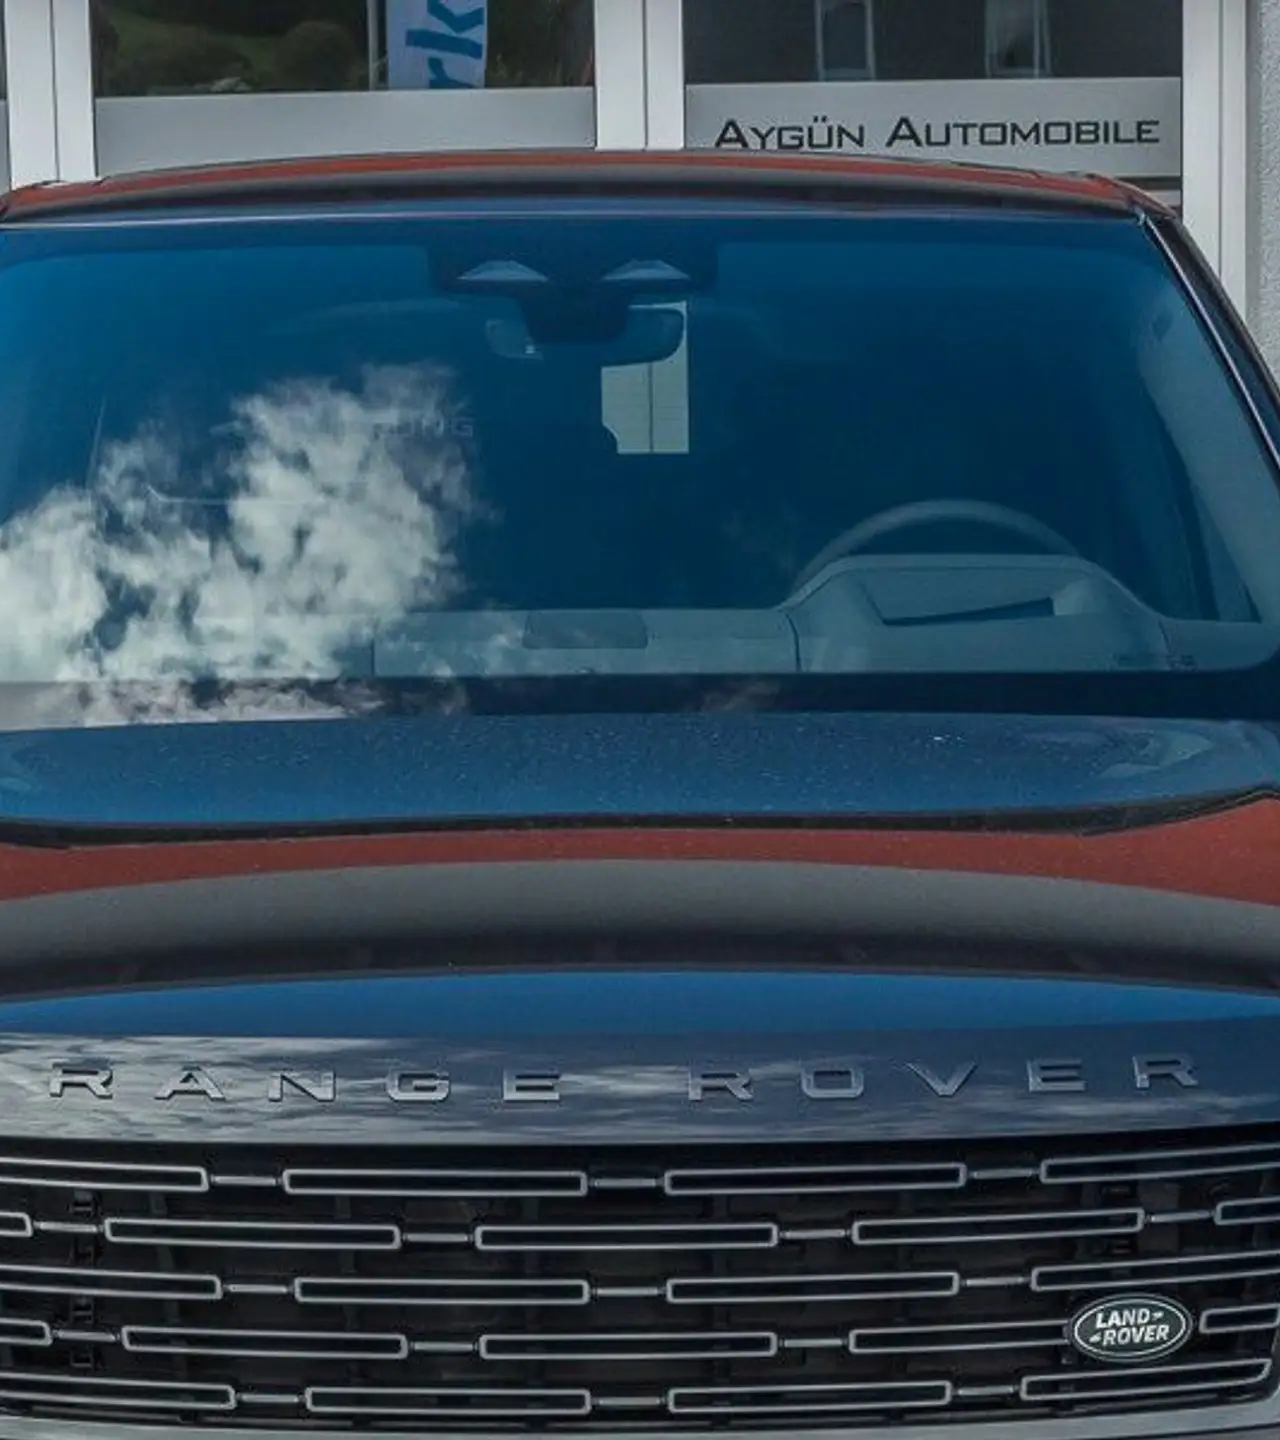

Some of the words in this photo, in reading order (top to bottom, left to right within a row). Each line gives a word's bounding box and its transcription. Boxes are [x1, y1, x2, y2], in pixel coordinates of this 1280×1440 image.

[49, 1061, 562, 1101] RANGE
[688, 1053, 1201, 1101] ROVER
[1095, 1307, 1151, 1330] LAND
[1102, 1323, 1171, 1348] ROVER
